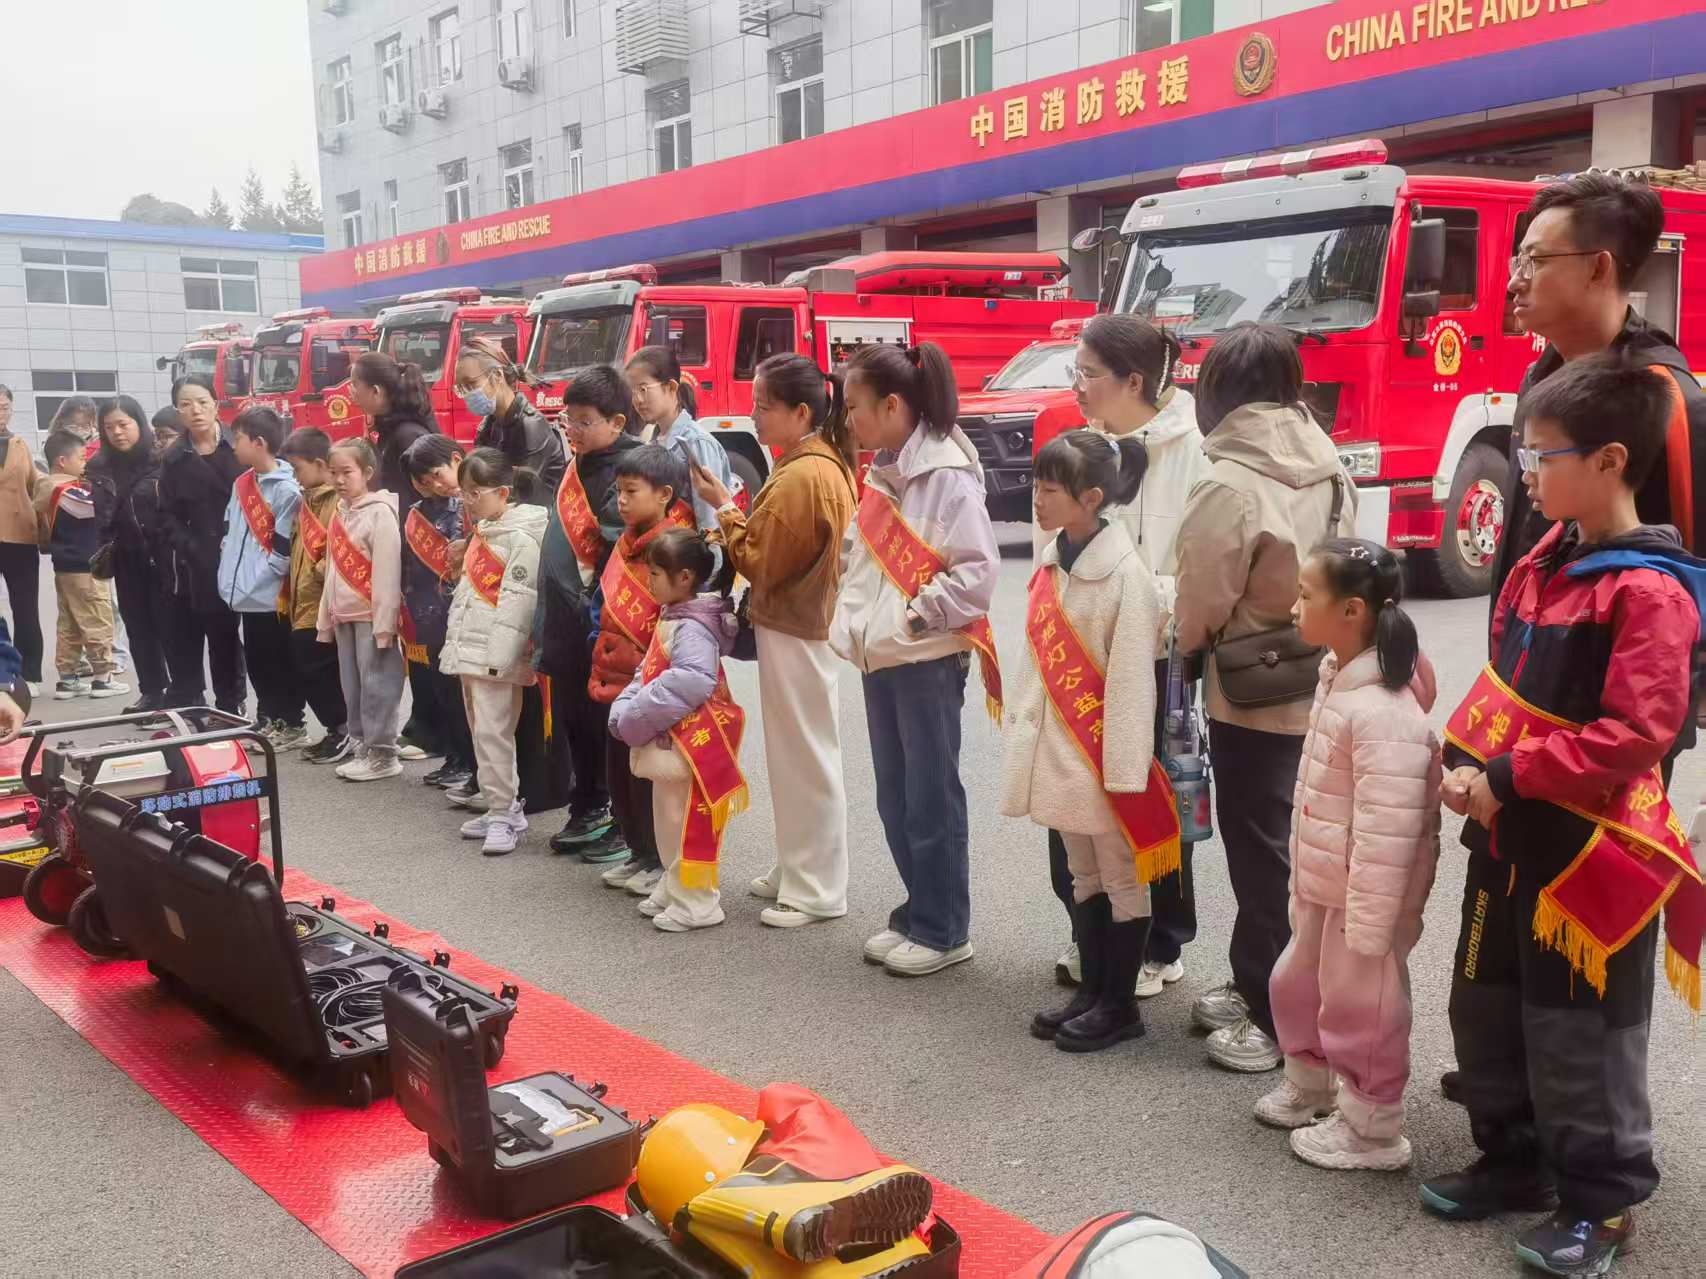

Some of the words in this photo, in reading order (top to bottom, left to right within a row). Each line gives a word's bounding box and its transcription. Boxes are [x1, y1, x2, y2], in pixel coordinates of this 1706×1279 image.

[1326, 10, 1406, 62] CHINA
[1412, 0, 1473, 43] FIRE
[970, 55, 1190, 148] 中国消防救援
[354, 238, 427, 276] 中国消防救援
[460, 230, 483, 251] CHINA
[484, 225, 501, 246] FIRE
[501, 221, 517, 243] AND
[518, 215, 551, 238] RESCUE
[1464, 888, 1490, 981] SKATEBOARD
